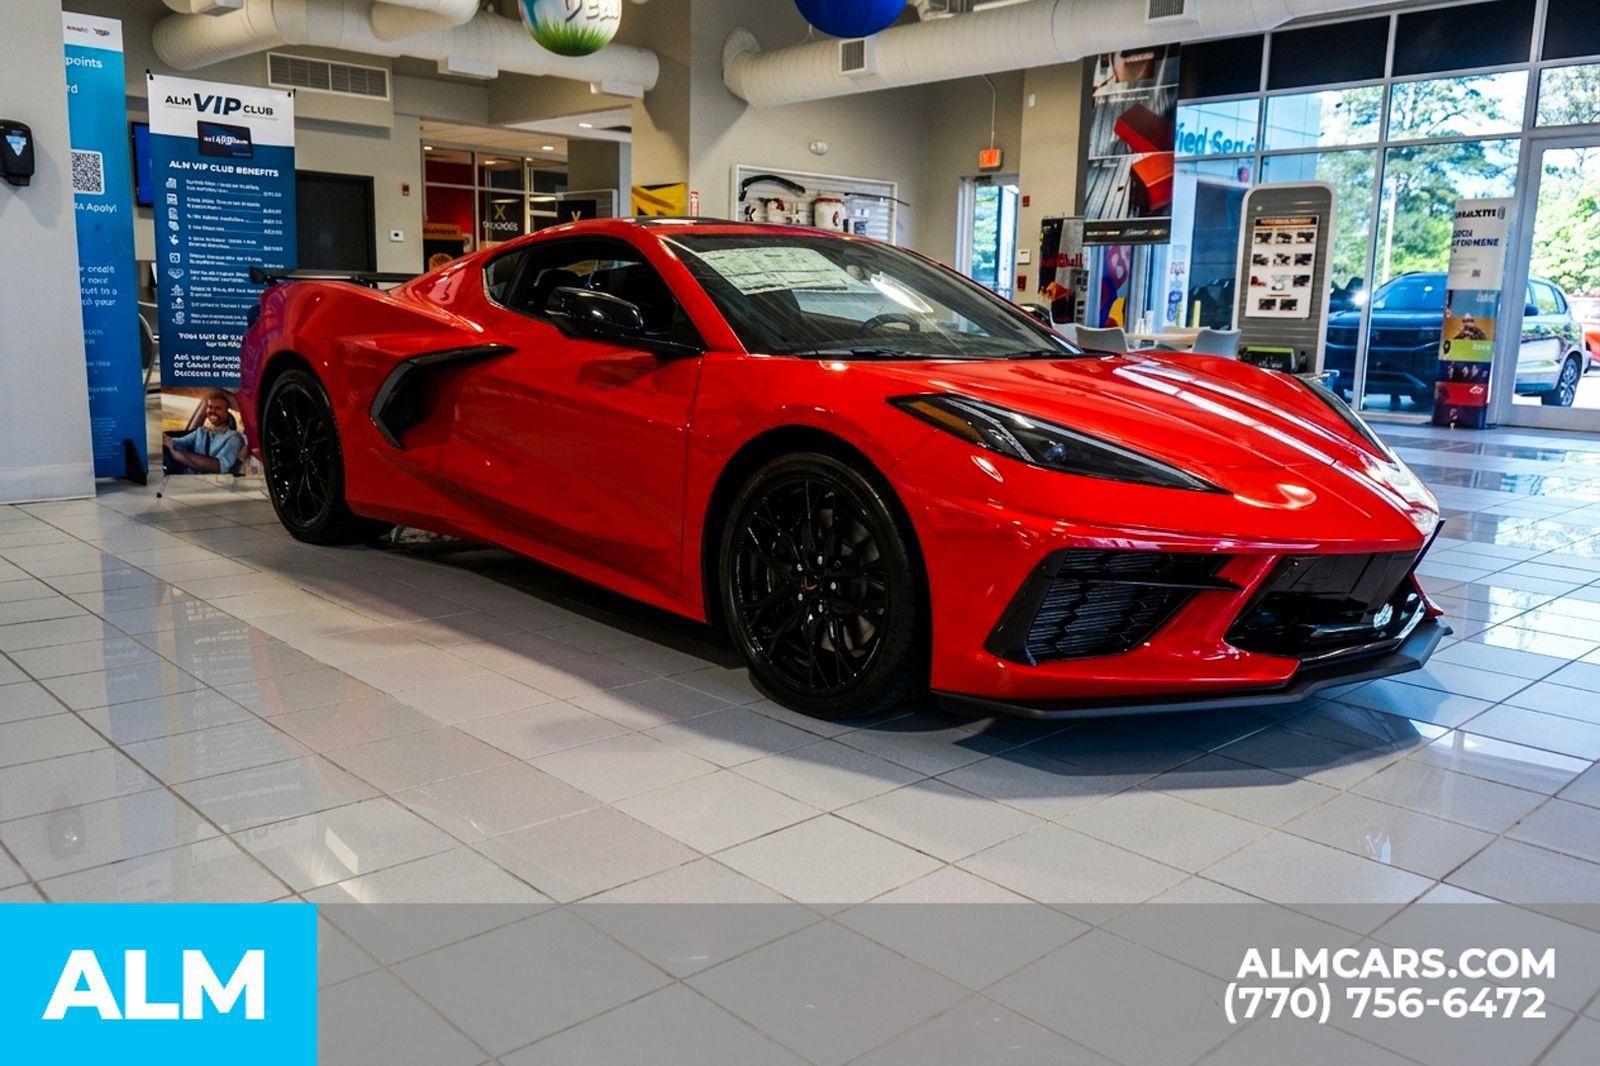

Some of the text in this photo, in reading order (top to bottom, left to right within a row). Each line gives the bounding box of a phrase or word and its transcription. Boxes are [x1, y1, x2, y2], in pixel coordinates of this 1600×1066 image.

[66, 56, 103, 69] points
[165, 93, 274, 116] ALM VIP CLUB
[169, 160, 280, 178] ALM VIP CLUB BENEFITS
